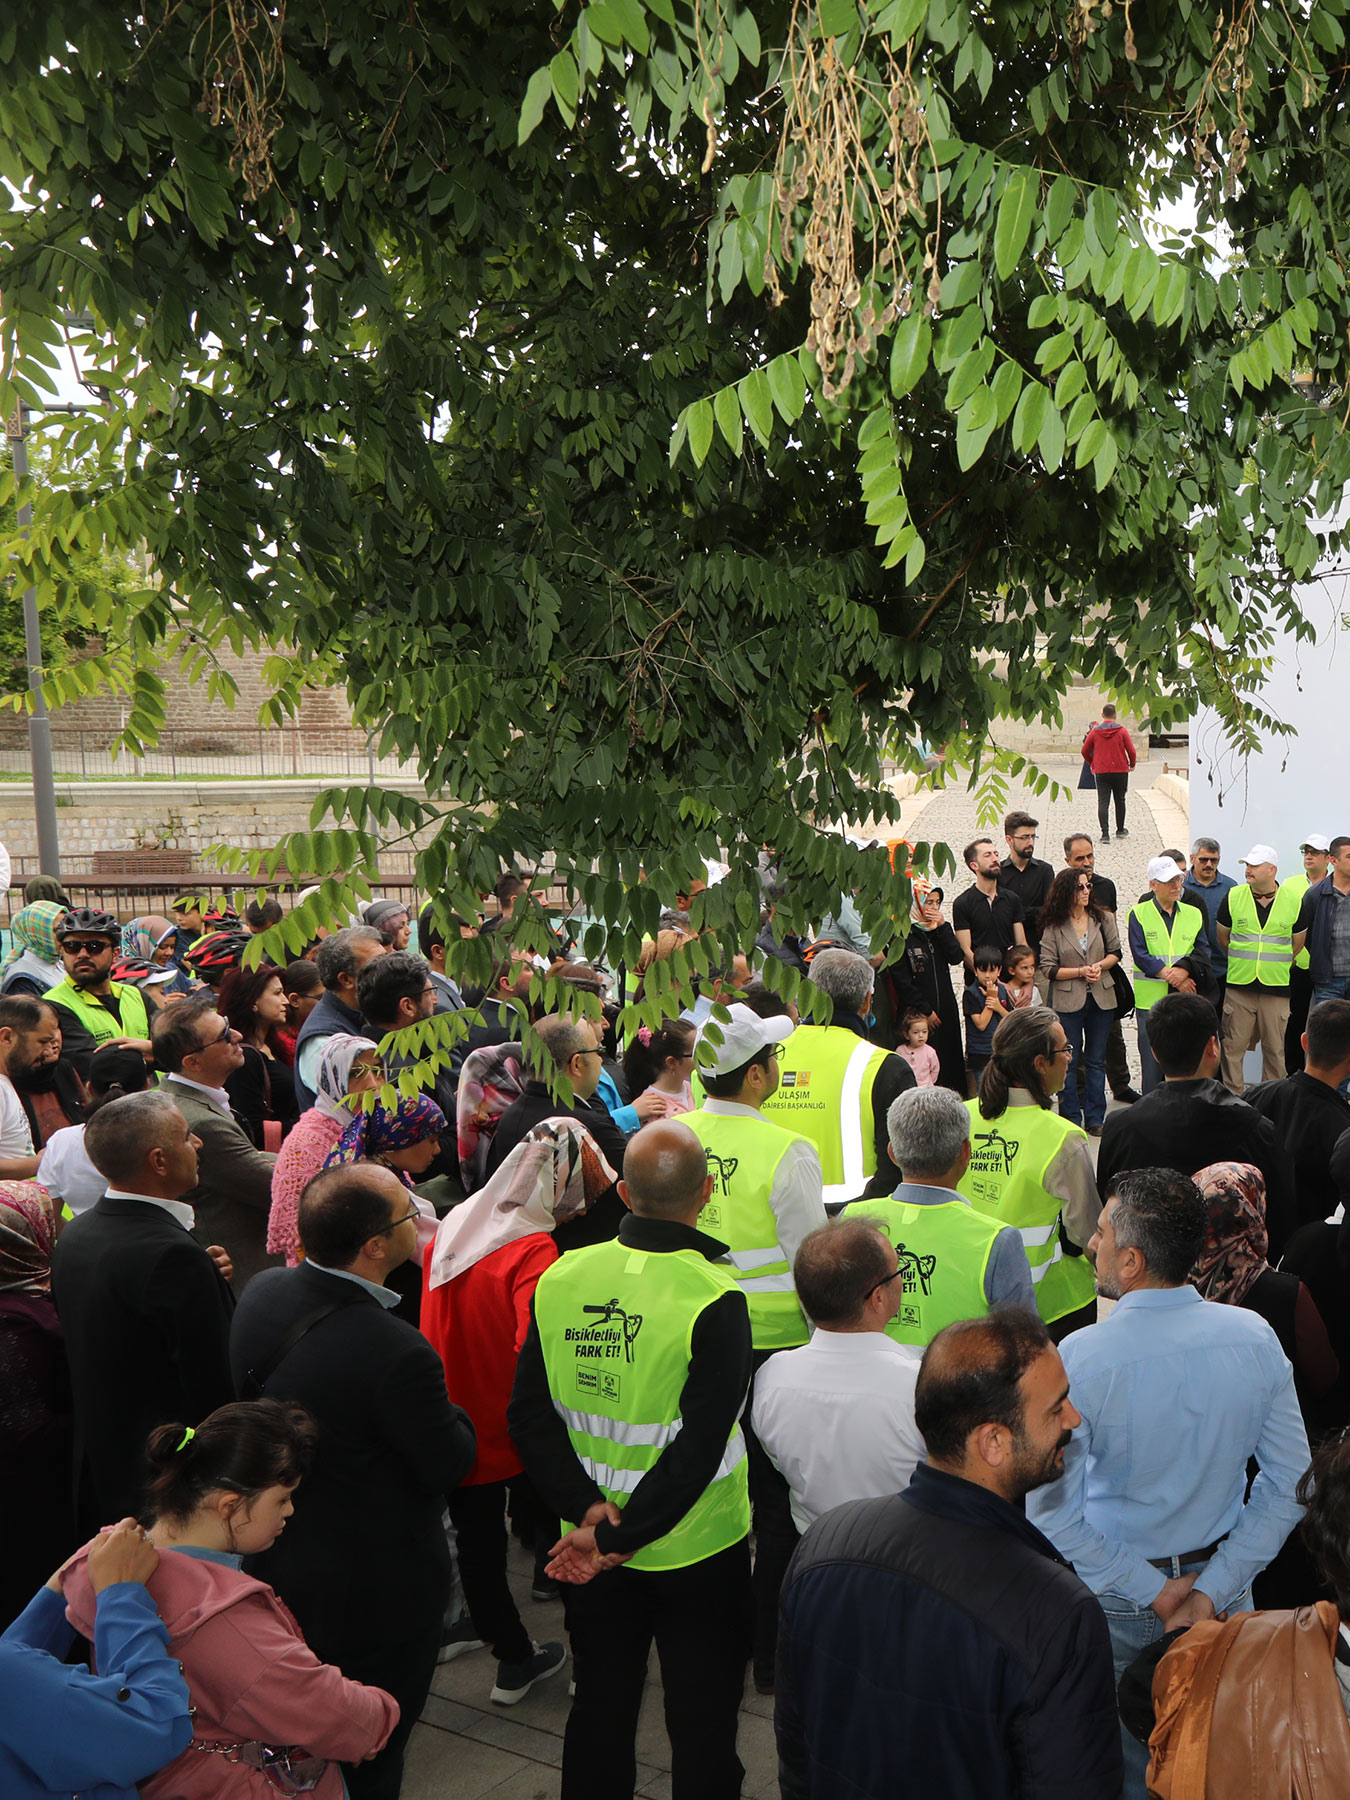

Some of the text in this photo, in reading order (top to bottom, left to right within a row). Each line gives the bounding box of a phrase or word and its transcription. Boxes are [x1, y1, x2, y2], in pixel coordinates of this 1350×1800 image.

[778, 1091, 810, 1101] ULAŞIM
[788, 1101, 825, 1110] BAŞKANLIĞI
[970, 1162, 1002, 1172] FARK ET!
[903, 1282, 916, 1293] ET!
[565, 1328, 622, 1344] Bisikletliyi
[575, 1345, 621, 1358] FARK ET!
